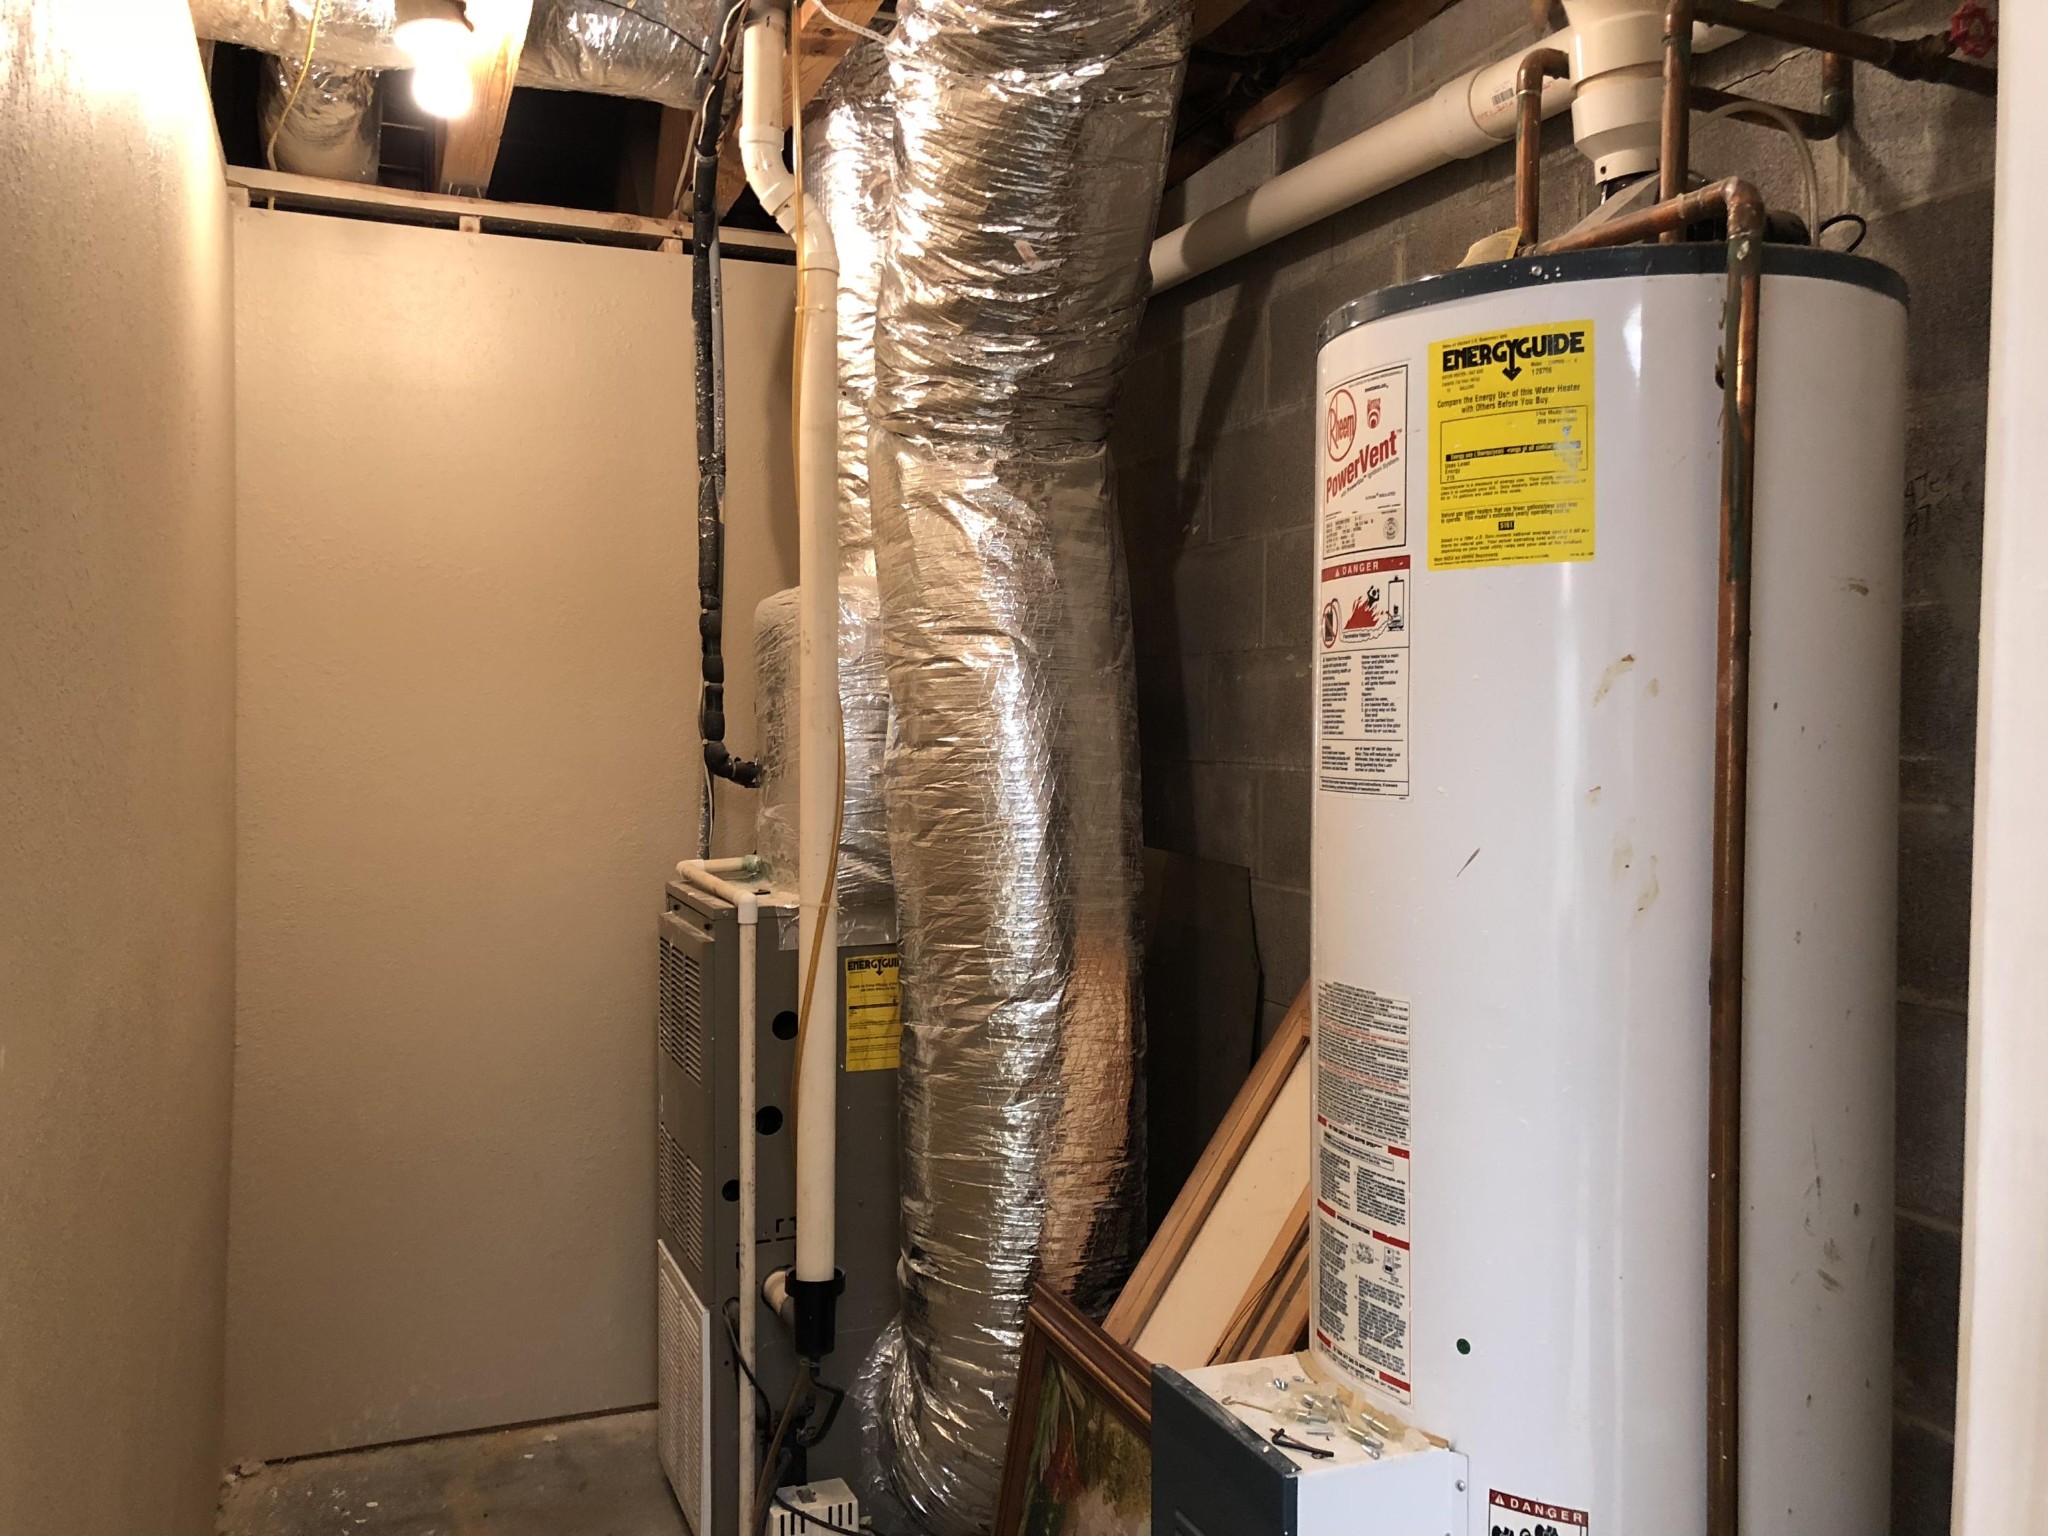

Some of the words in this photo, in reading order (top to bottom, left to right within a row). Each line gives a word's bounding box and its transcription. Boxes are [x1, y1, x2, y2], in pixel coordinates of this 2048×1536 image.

[1443, 331, 1585, 373] ENERGYGUIDE
[1437, 399, 1462, 409] Compare
[1463, 396, 1473, 404] the
[1475, 394, 1496, 403] Energy
[1512, 389, 1519, 397] of
[1520, 387, 1533, 396] this
[1535, 385, 1555, 395] Water
[1557, 384, 1581, 393] Heater
[1461, 405, 1474, 414] with
[1475, 402, 1496, 412] Others
[1497, 399, 1519, 409] Before
[1521, 397, 1534, 406] You
[1342, 561, 1379, 575] DANGER
[1510, 1498, 1582, 1523] DANGER
